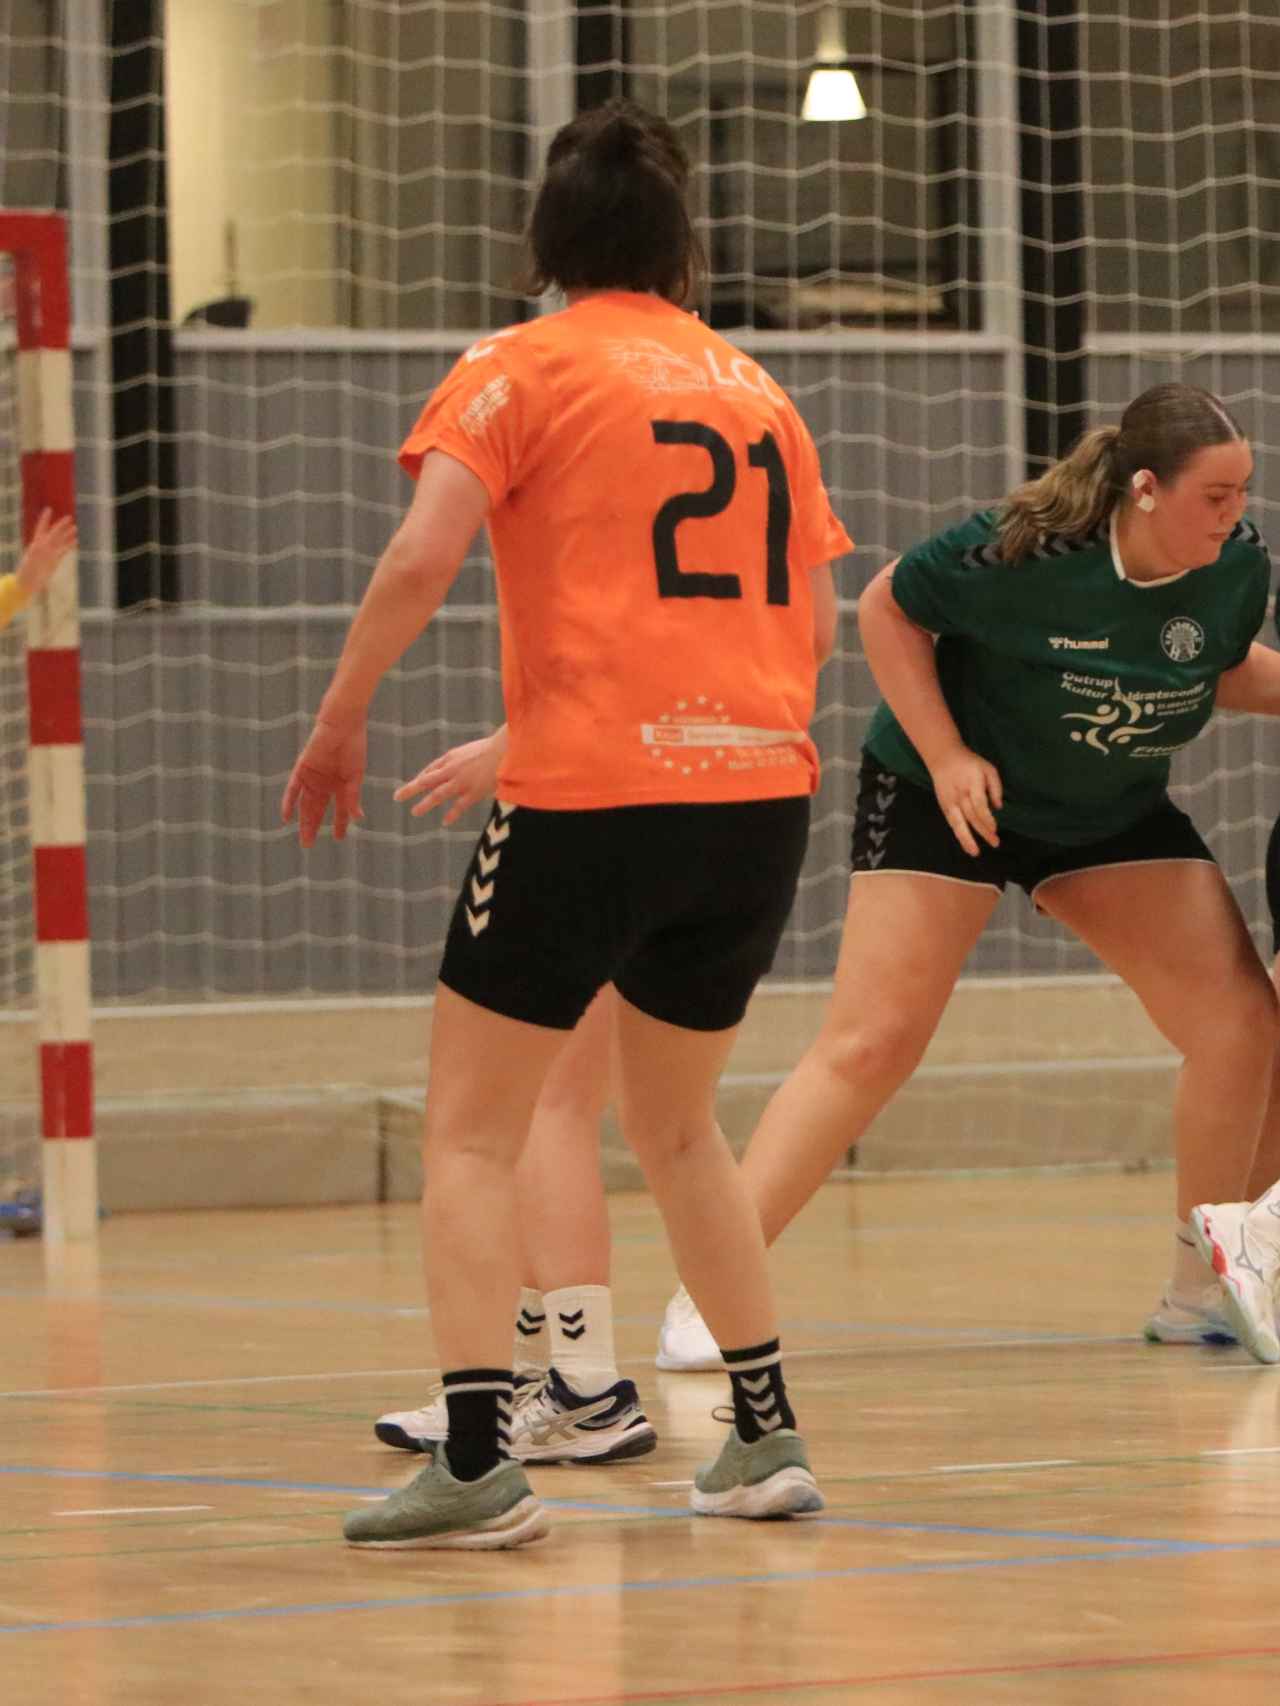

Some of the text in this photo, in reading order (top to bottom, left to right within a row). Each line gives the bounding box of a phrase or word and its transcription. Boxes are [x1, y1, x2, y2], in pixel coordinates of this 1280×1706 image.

[651, 419, 792, 607] 21
[1061, 671, 1113, 688] Outrup
[1060, 680, 1107, 699] Kultur
